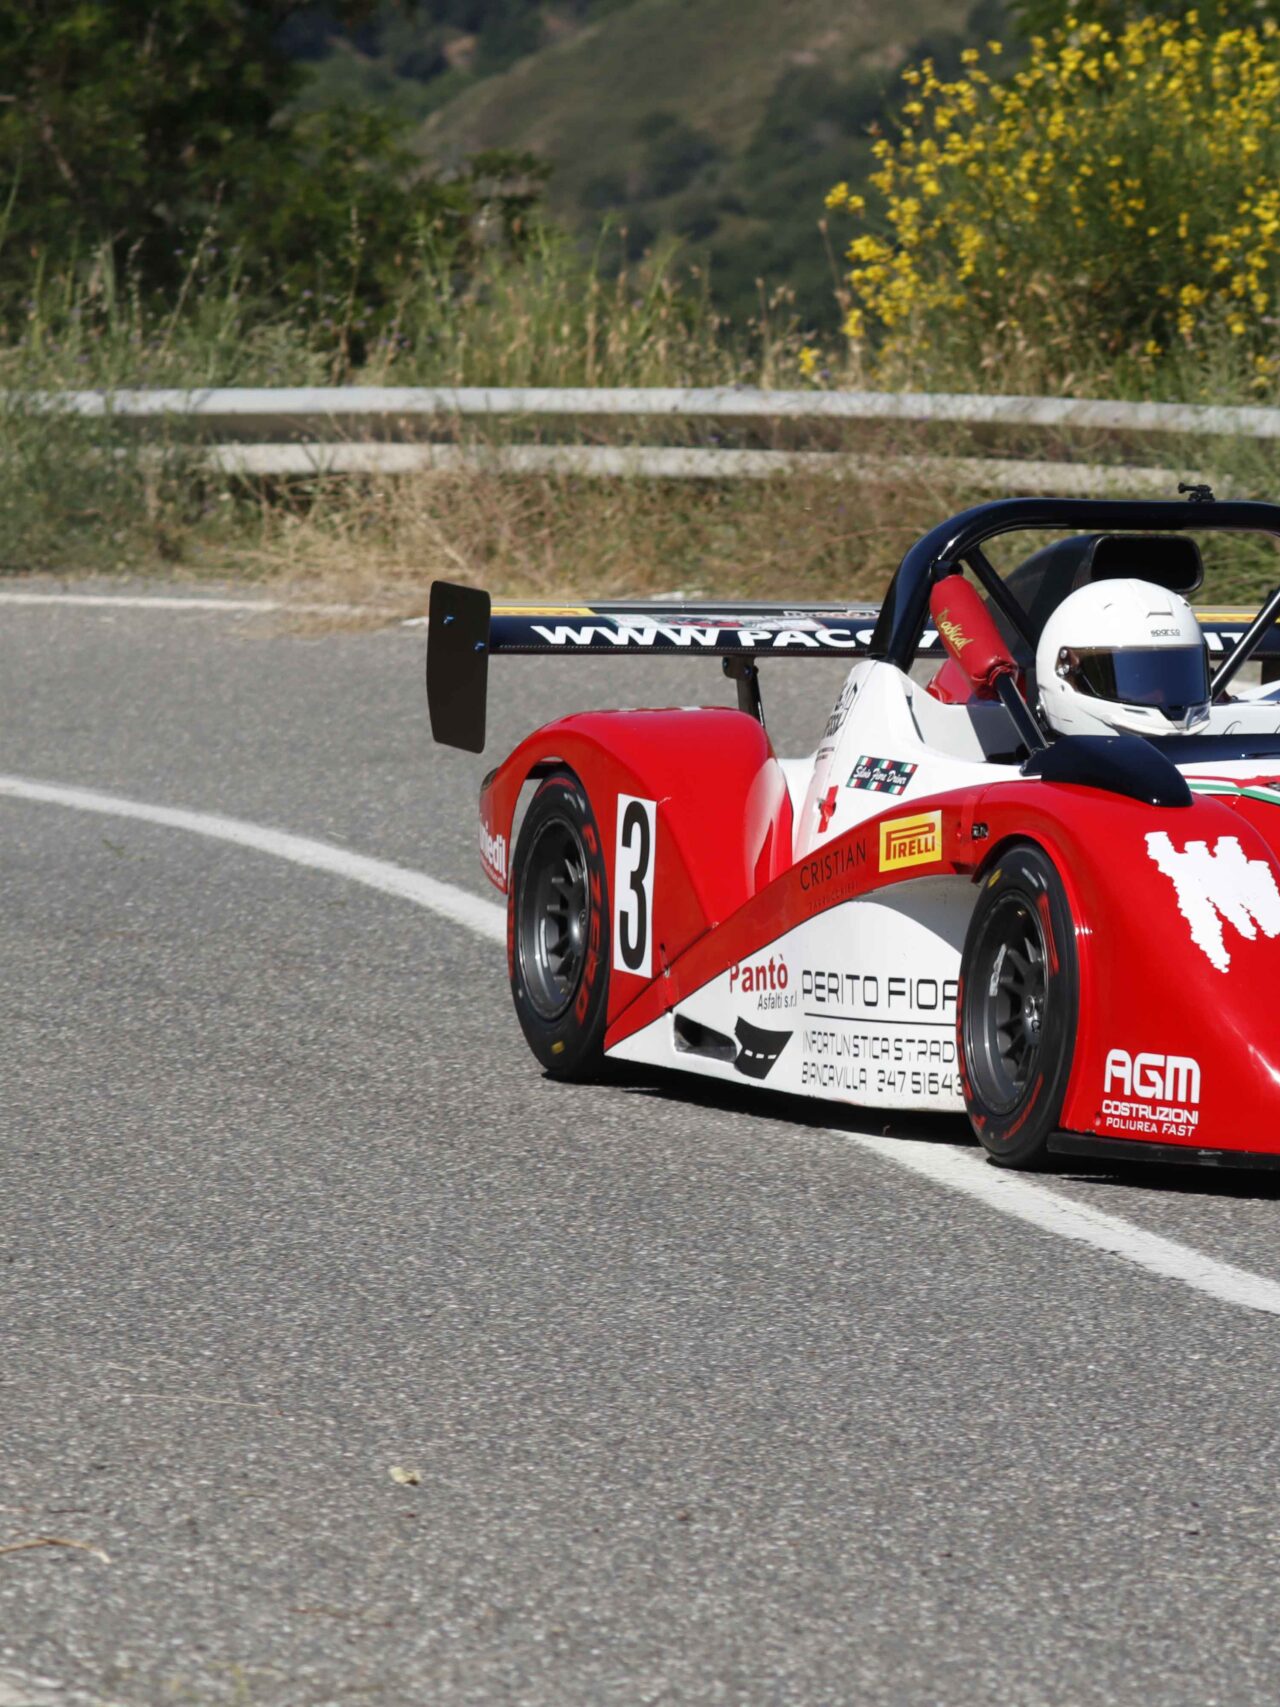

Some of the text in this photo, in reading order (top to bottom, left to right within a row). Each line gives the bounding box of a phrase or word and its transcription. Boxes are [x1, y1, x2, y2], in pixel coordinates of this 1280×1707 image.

[530, 625, 720, 646] WWW
[885, 822, 936, 860] PIRELLI
[800, 838, 867, 891] CRISTIAN
[619, 800, 651, 971] 3
[729, 953, 788, 994] Pantò
[802, 969, 878, 1007] PERITO
[757, 992, 783, 1010] Asfalti
[894, 1038, 955, 1064] STRAD
[1103, 1048, 1201, 1104] AGM
[1102, 1099, 1199, 1125] COSTRUZIONI
[1106, 1116, 1196, 1137] POLIUREA FAST
